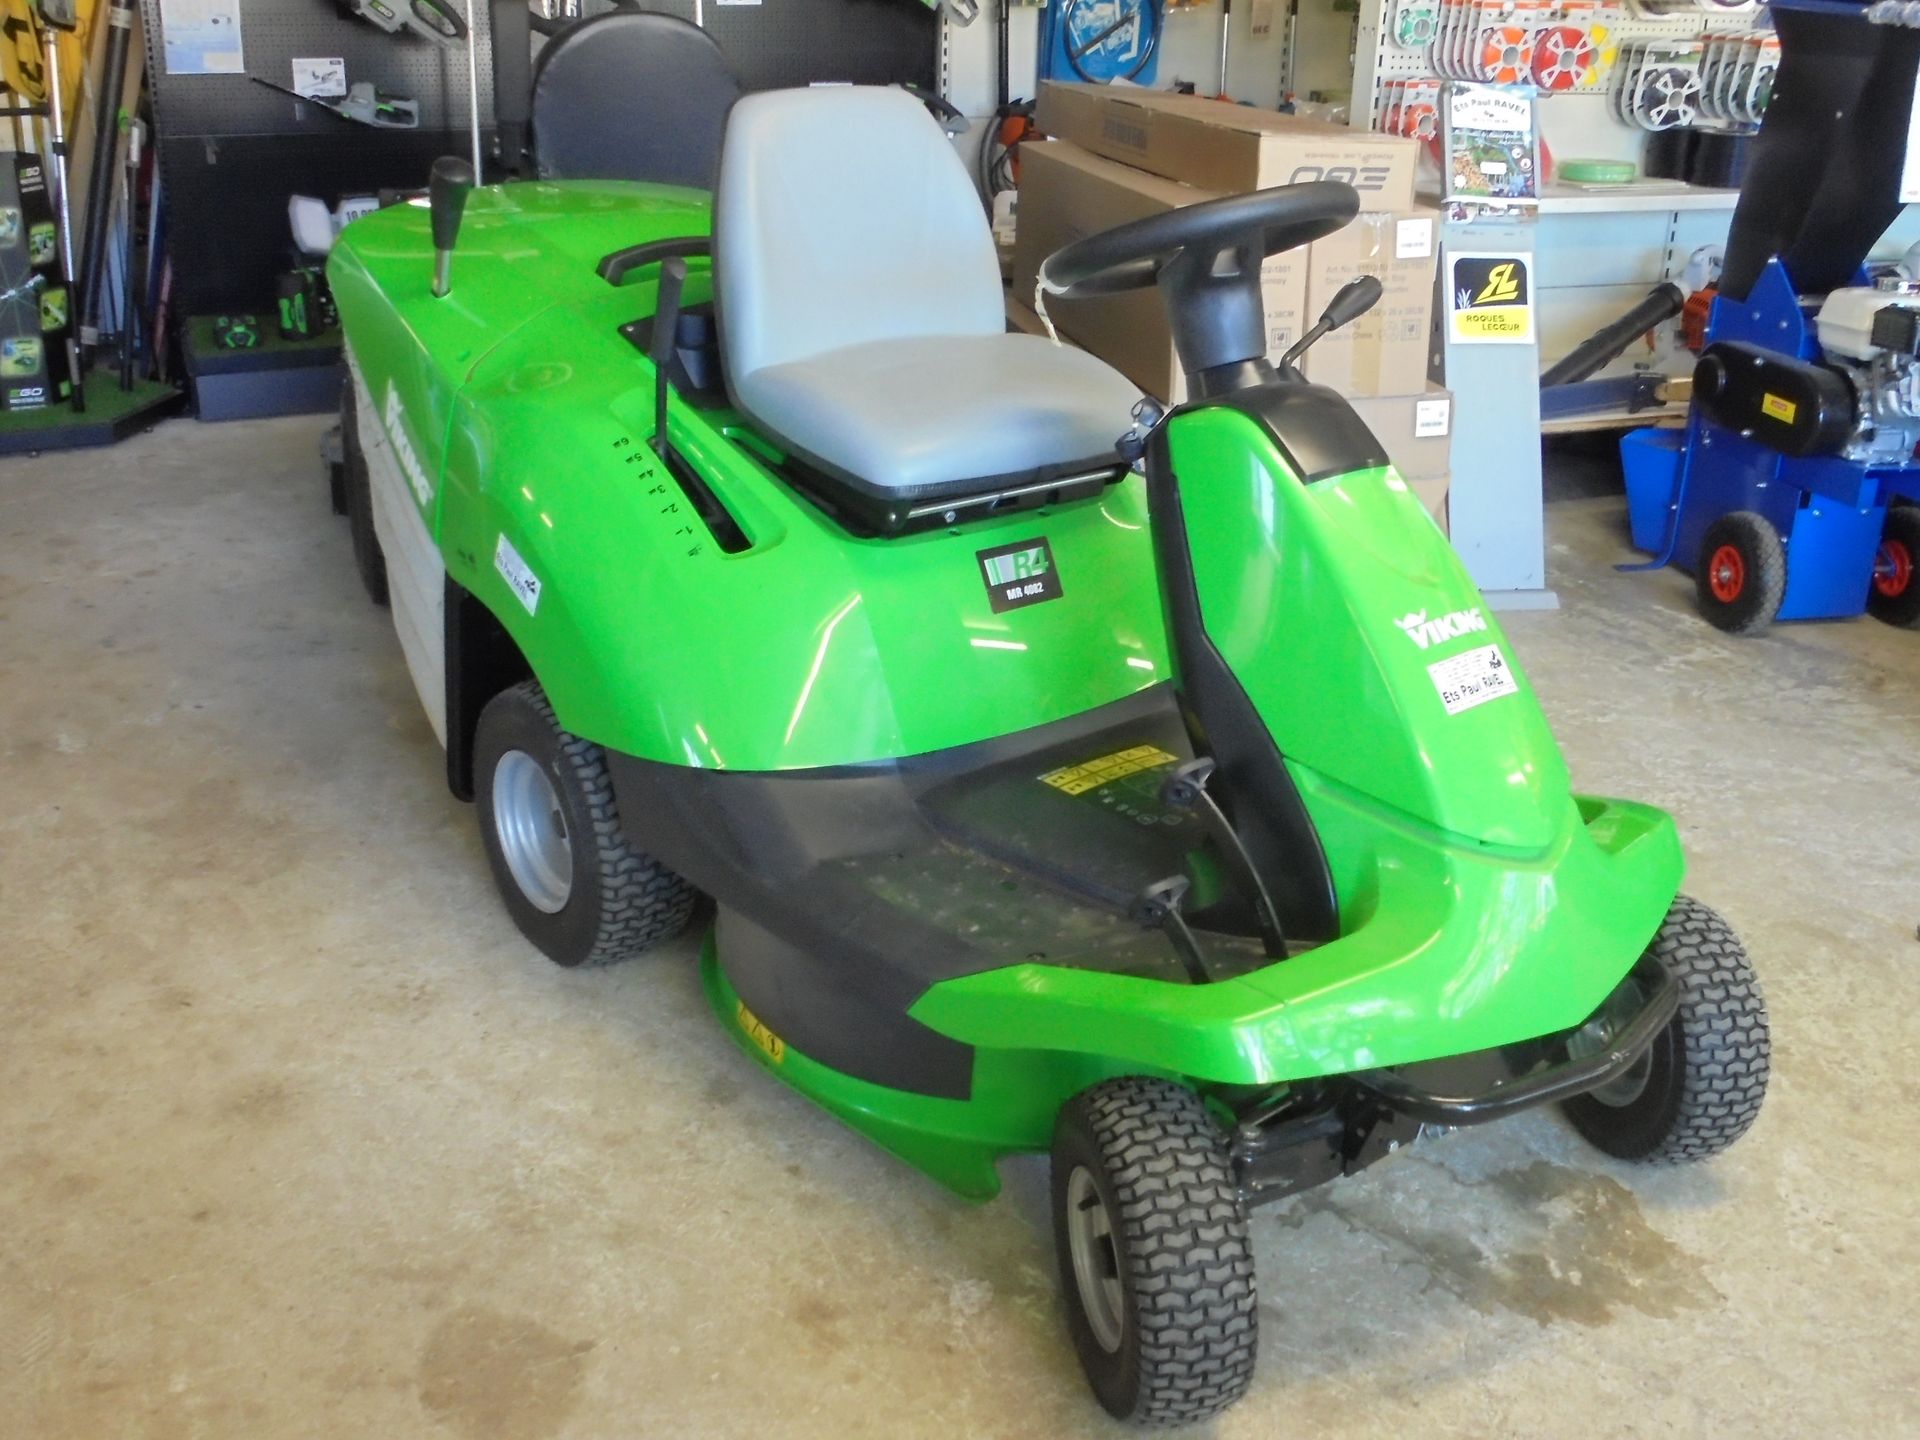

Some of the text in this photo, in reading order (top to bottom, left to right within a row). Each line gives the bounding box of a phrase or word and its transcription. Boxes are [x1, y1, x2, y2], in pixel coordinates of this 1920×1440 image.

[1471, 99, 1491, 107] Paul
[1494, 99, 1526, 115] RAVEL
[1465, 314, 1505, 323] ROQUES
[1006, 587, 1023, 600] MR
[1405, 607, 1488, 650] VIKING
[1442, 691, 1460, 704] Ets
[1460, 684, 1482, 698] Paul
